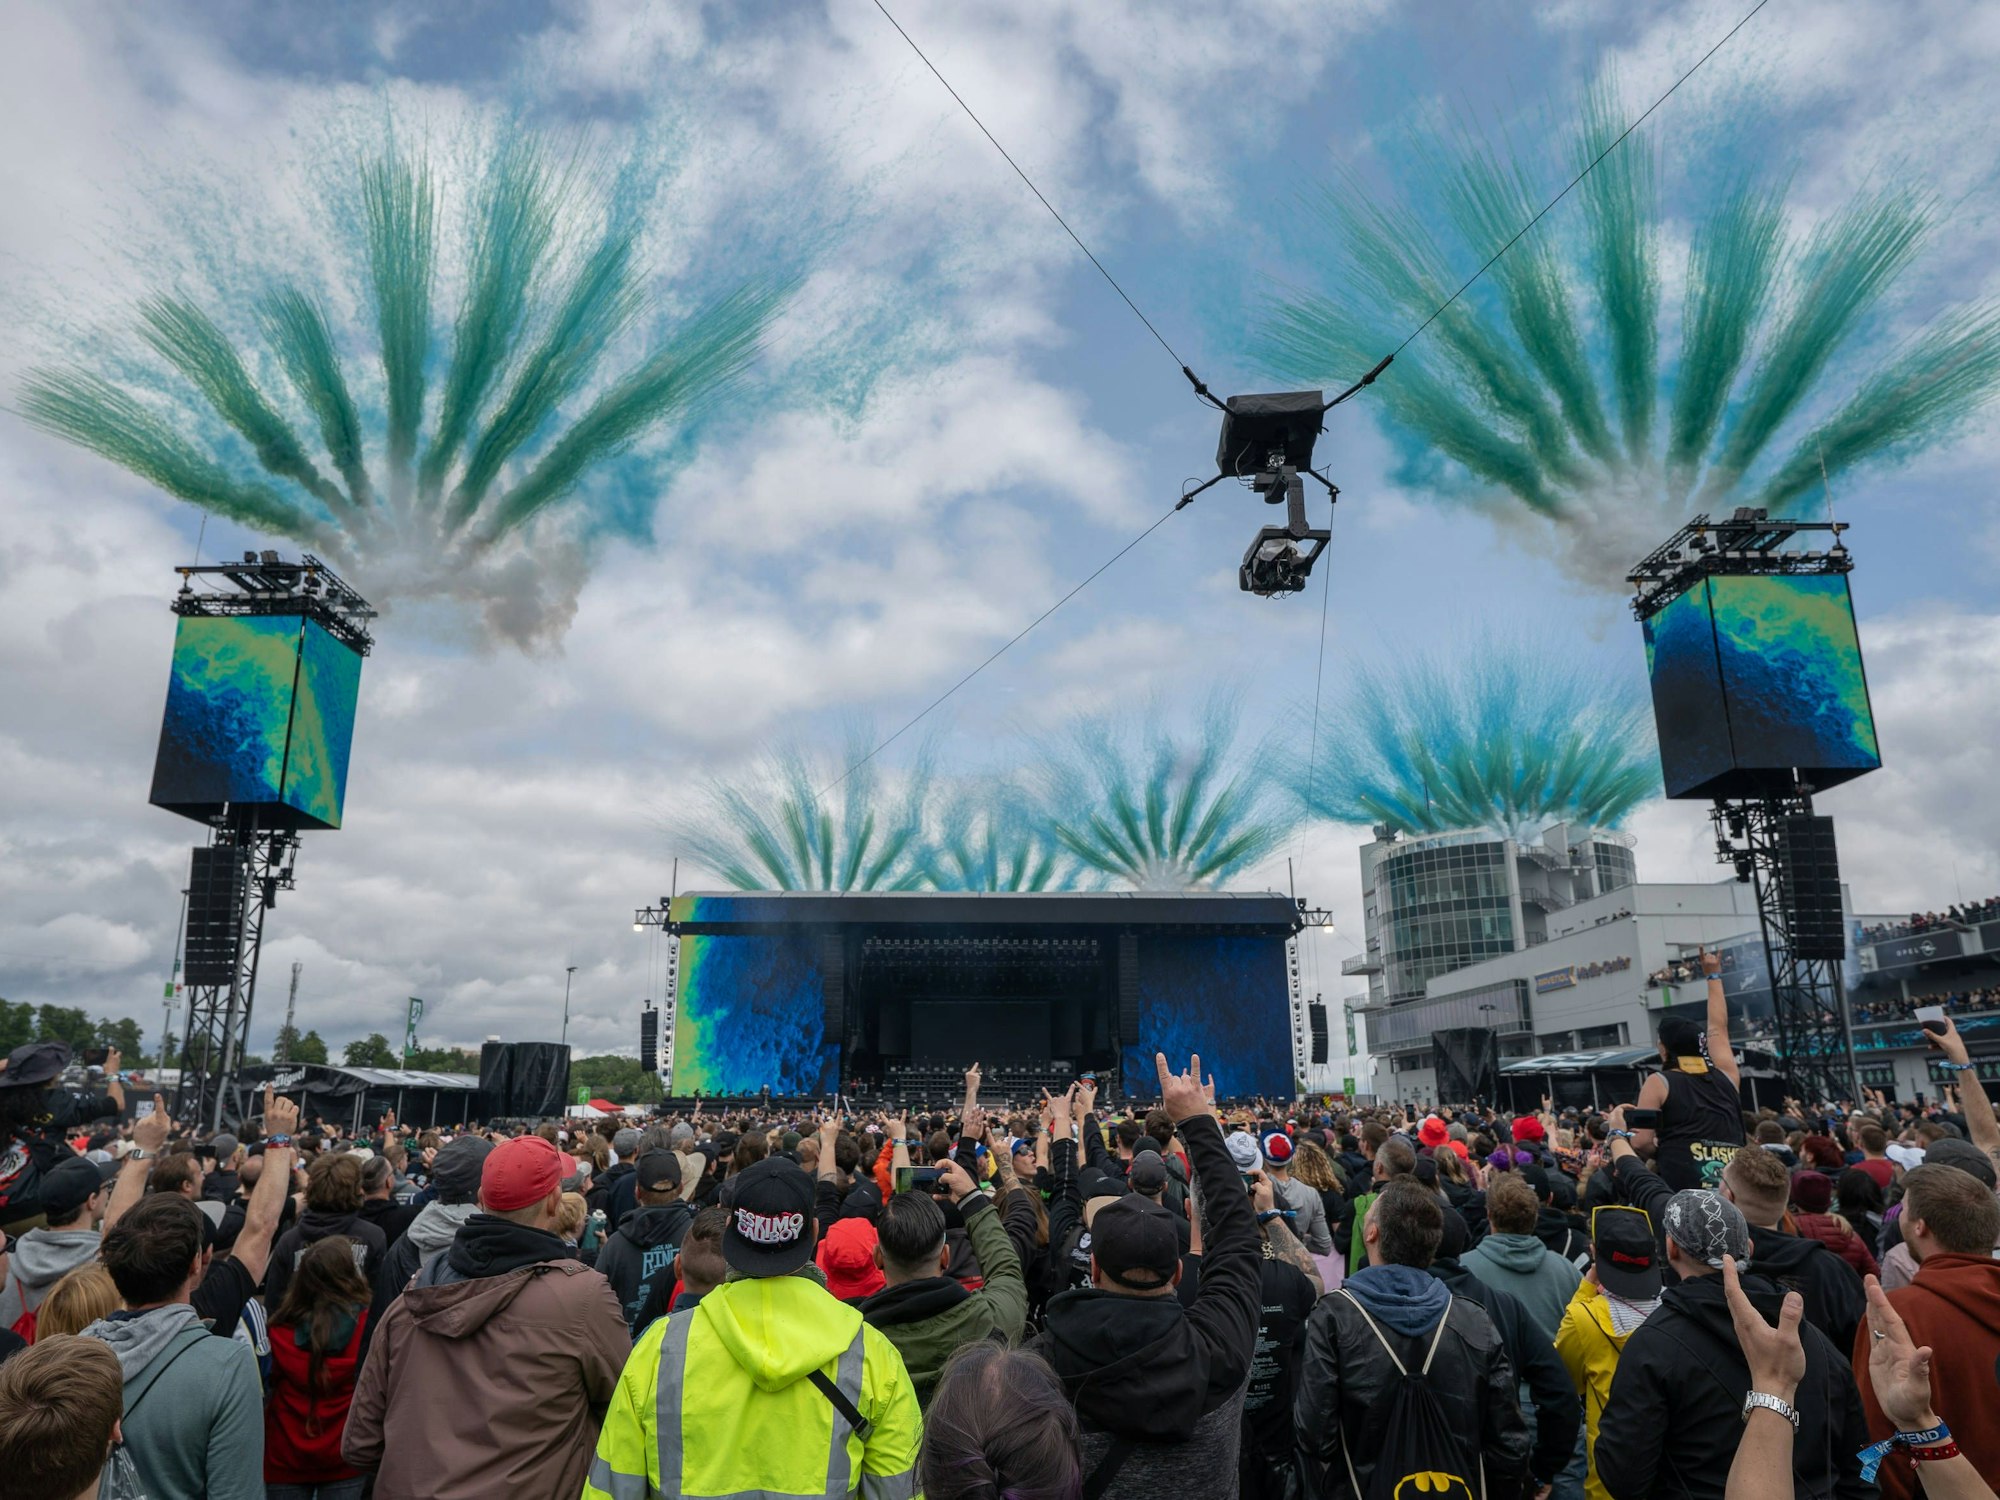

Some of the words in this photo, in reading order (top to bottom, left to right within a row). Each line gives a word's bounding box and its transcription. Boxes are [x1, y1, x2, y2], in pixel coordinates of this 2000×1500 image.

[1896, 947, 1919, 957] OPEL
[1690, 1142, 1743, 1165] SLASH
[734, 1208, 803, 1237] ESKIMO
